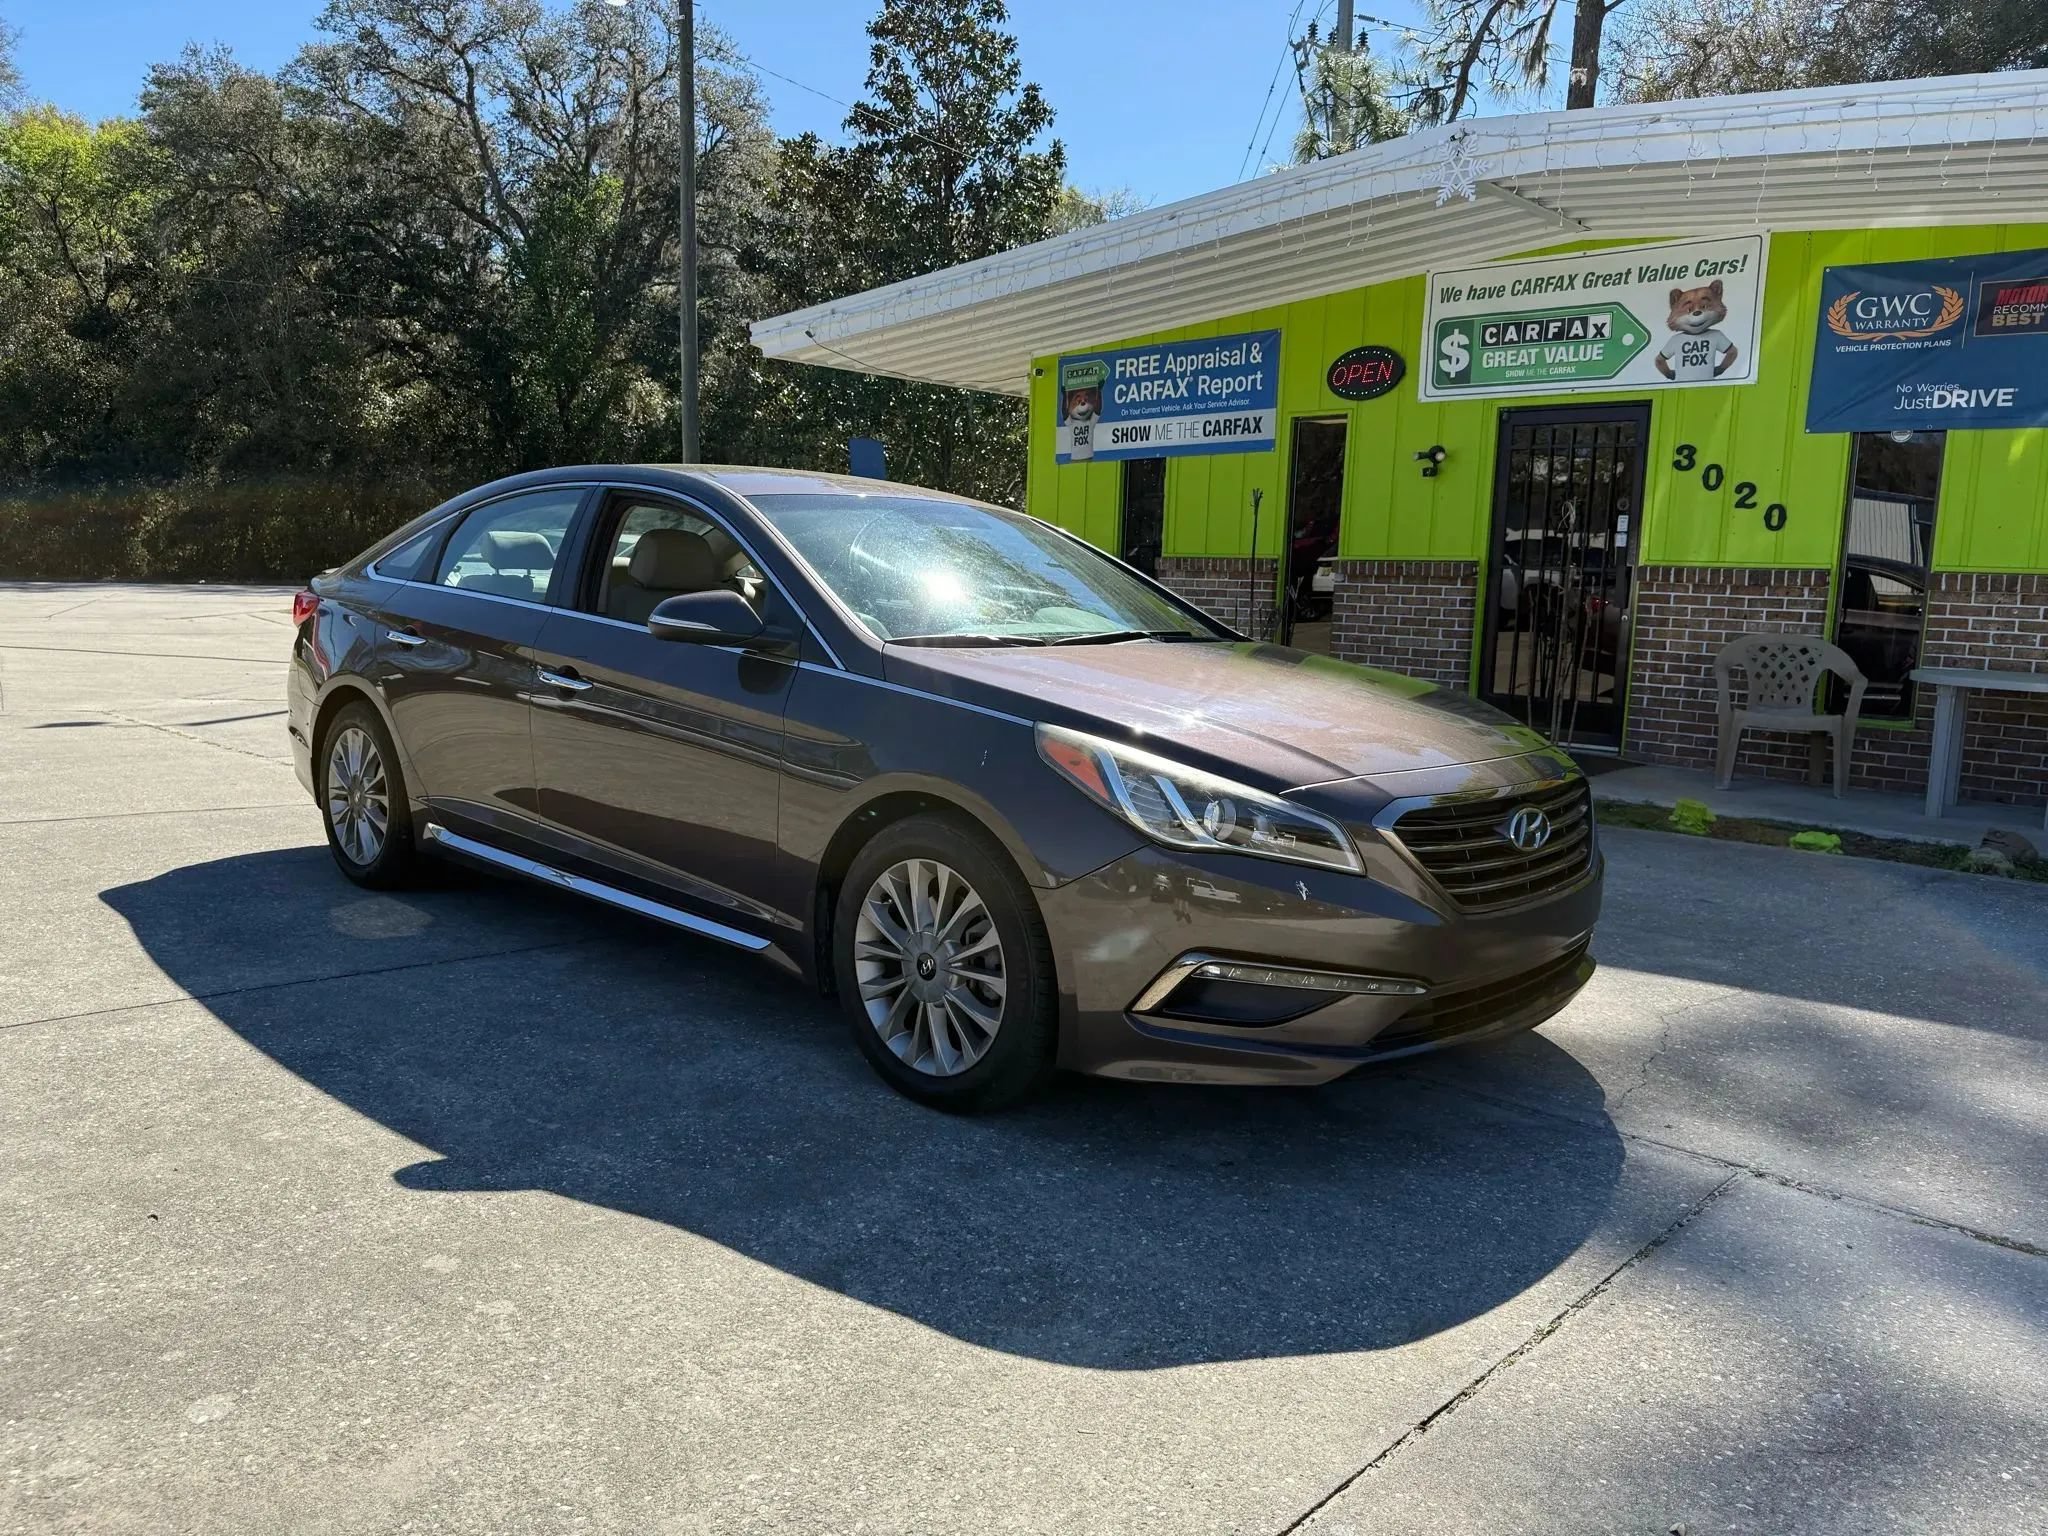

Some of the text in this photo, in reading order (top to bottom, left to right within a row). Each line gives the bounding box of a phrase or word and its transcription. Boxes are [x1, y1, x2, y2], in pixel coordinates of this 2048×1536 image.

[1440, 254, 1748, 304] We have CARFAX Great Value Cars!
[1856, 293, 1932, 319] GWC
[1855, 317, 1929, 330] WARRANTY
[1992, 312, 2045, 327] BEST
[1484, 319, 1608, 344] CARFAX
[1439, 328, 1470, 378] $
[1482, 344, 1605, 369] GREAT VALUE
[1681, 340, 1710, 354] CAR
[1835, 339, 1951, 353] VEHICLE PROTECTION PLANS
[1115, 342, 1263, 379] FREE Appraisal &
[1682, 353, 1708, 367] FOX
[1332, 359, 1394, 386] OPEN
[1505, 369, 1525, 378] SHOW
[1549, 366, 1576, 375] CARFAX
[1197, 370, 1263, 399] Report
[1896, 384, 1913, 393] No
[1121, 408, 1129, 416] On
[1129, 407, 1141, 416] Your
[1141, 405, 1160, 414] Current
[1182, 402, 1193, 411] Ask
[1193, 402, 1206, 410] Your
[1207, 399, 1227, 408] Service
[1073, 425, 1090, 436] CAR
[1073, 435, 1089, 446] FOX
[1111, 416, 1264, 444] SHOW ME THE CARFAX
[1673, 443, 1787, 531] 3020
